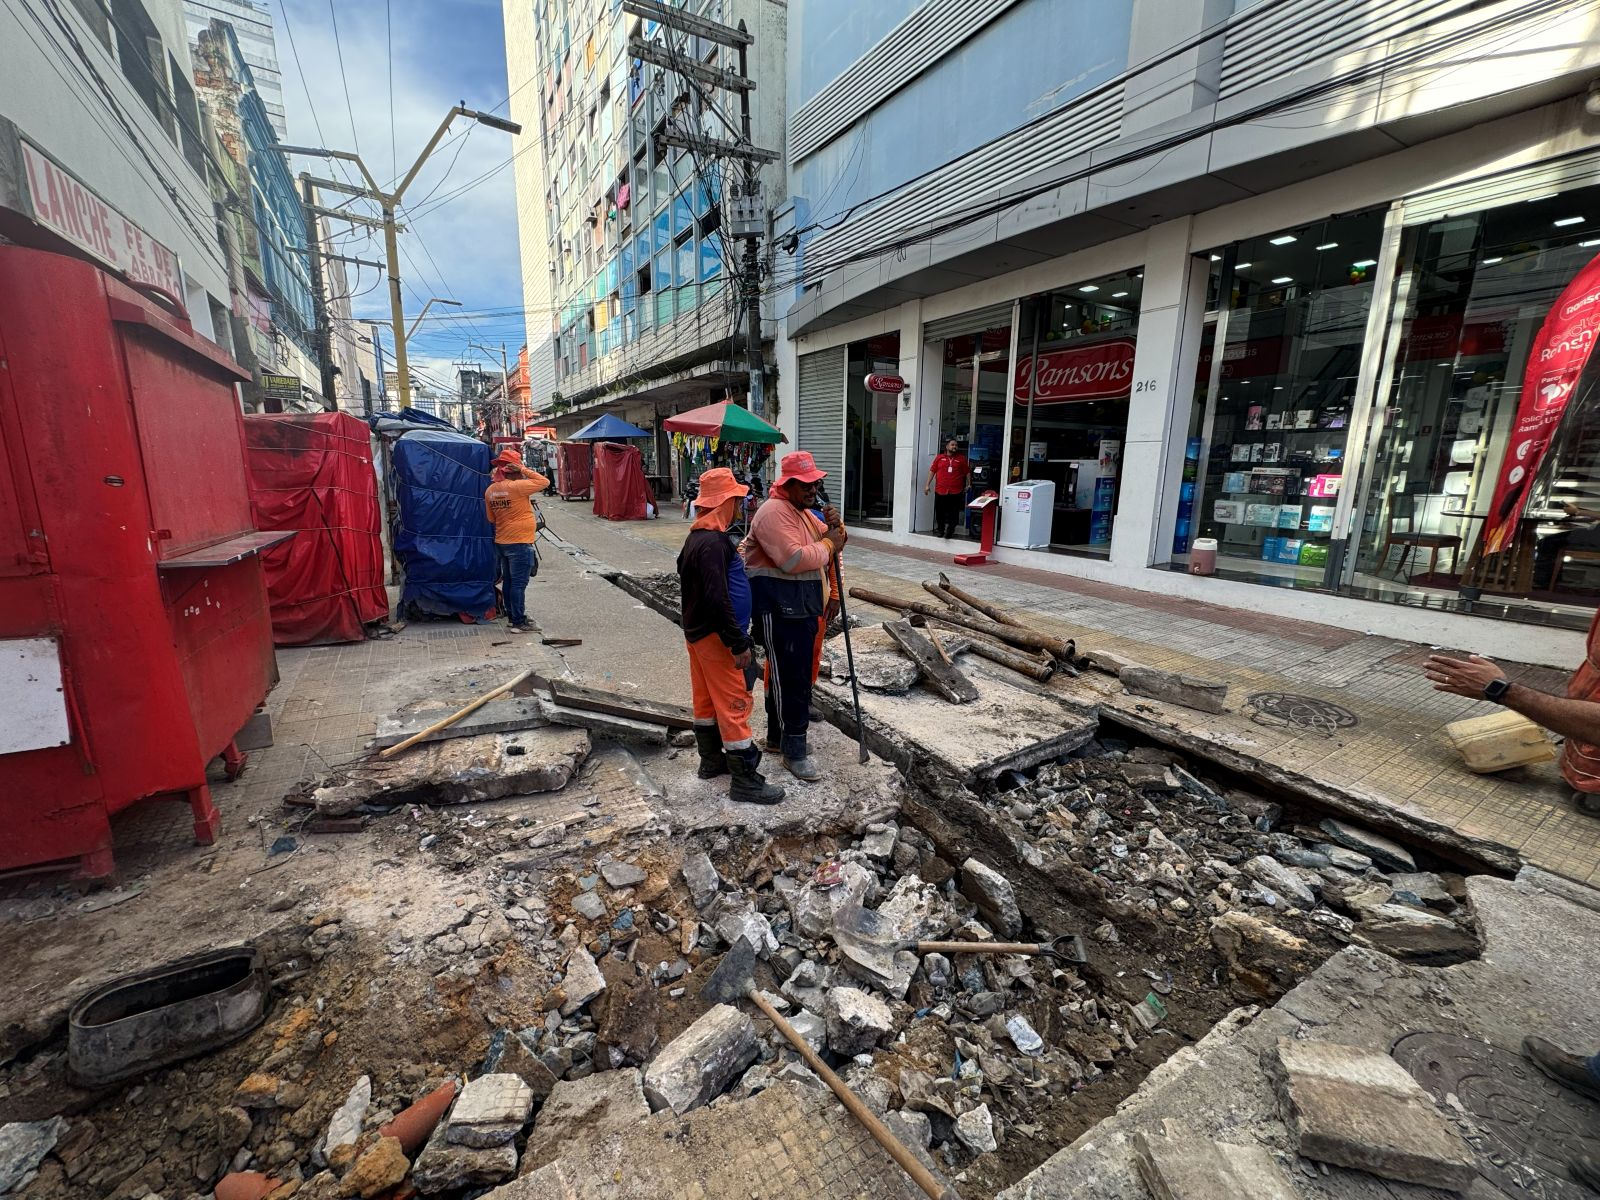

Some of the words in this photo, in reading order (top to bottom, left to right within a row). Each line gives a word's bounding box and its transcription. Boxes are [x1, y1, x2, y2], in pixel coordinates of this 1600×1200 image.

[24, 145, 117, 262] LANCHE
[151, 241, 172, 278] DE
[1016, 357, 1134, 396] Ramsons
[1136, 380, 1157, 393] 216
